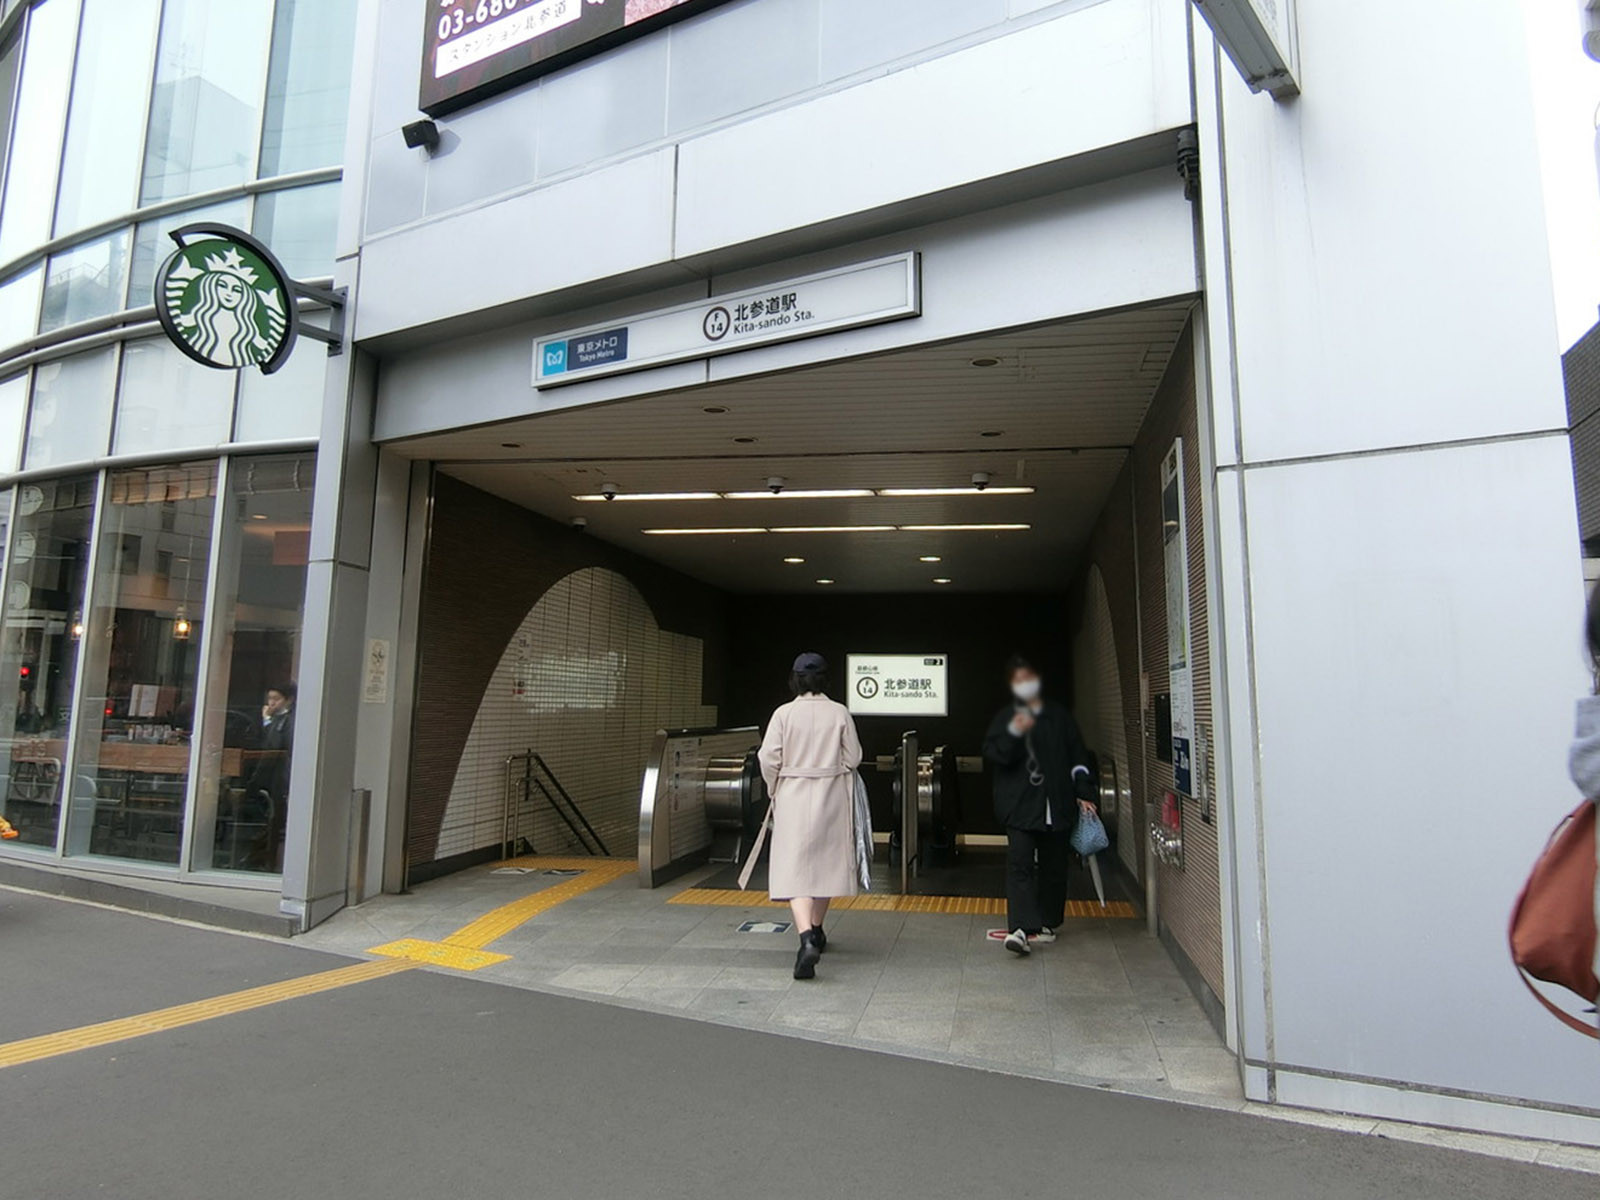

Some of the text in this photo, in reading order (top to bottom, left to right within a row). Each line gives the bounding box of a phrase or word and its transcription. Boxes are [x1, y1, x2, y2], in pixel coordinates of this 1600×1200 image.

[734, 293, 797, 321] 北参道駅
[714, 312, 719, 322] F
[734, 310, 815, 334] Kita-sando Sta.
[711, 323, 723, 333] 14
[577, 336, 618, 354] 東京メトロ
[579, 349, 615, 363] Tokyo Metro
[884, 678, 932, 690] 北参道駅
[884, 690, 938, 698] Kita-sando Sta.
